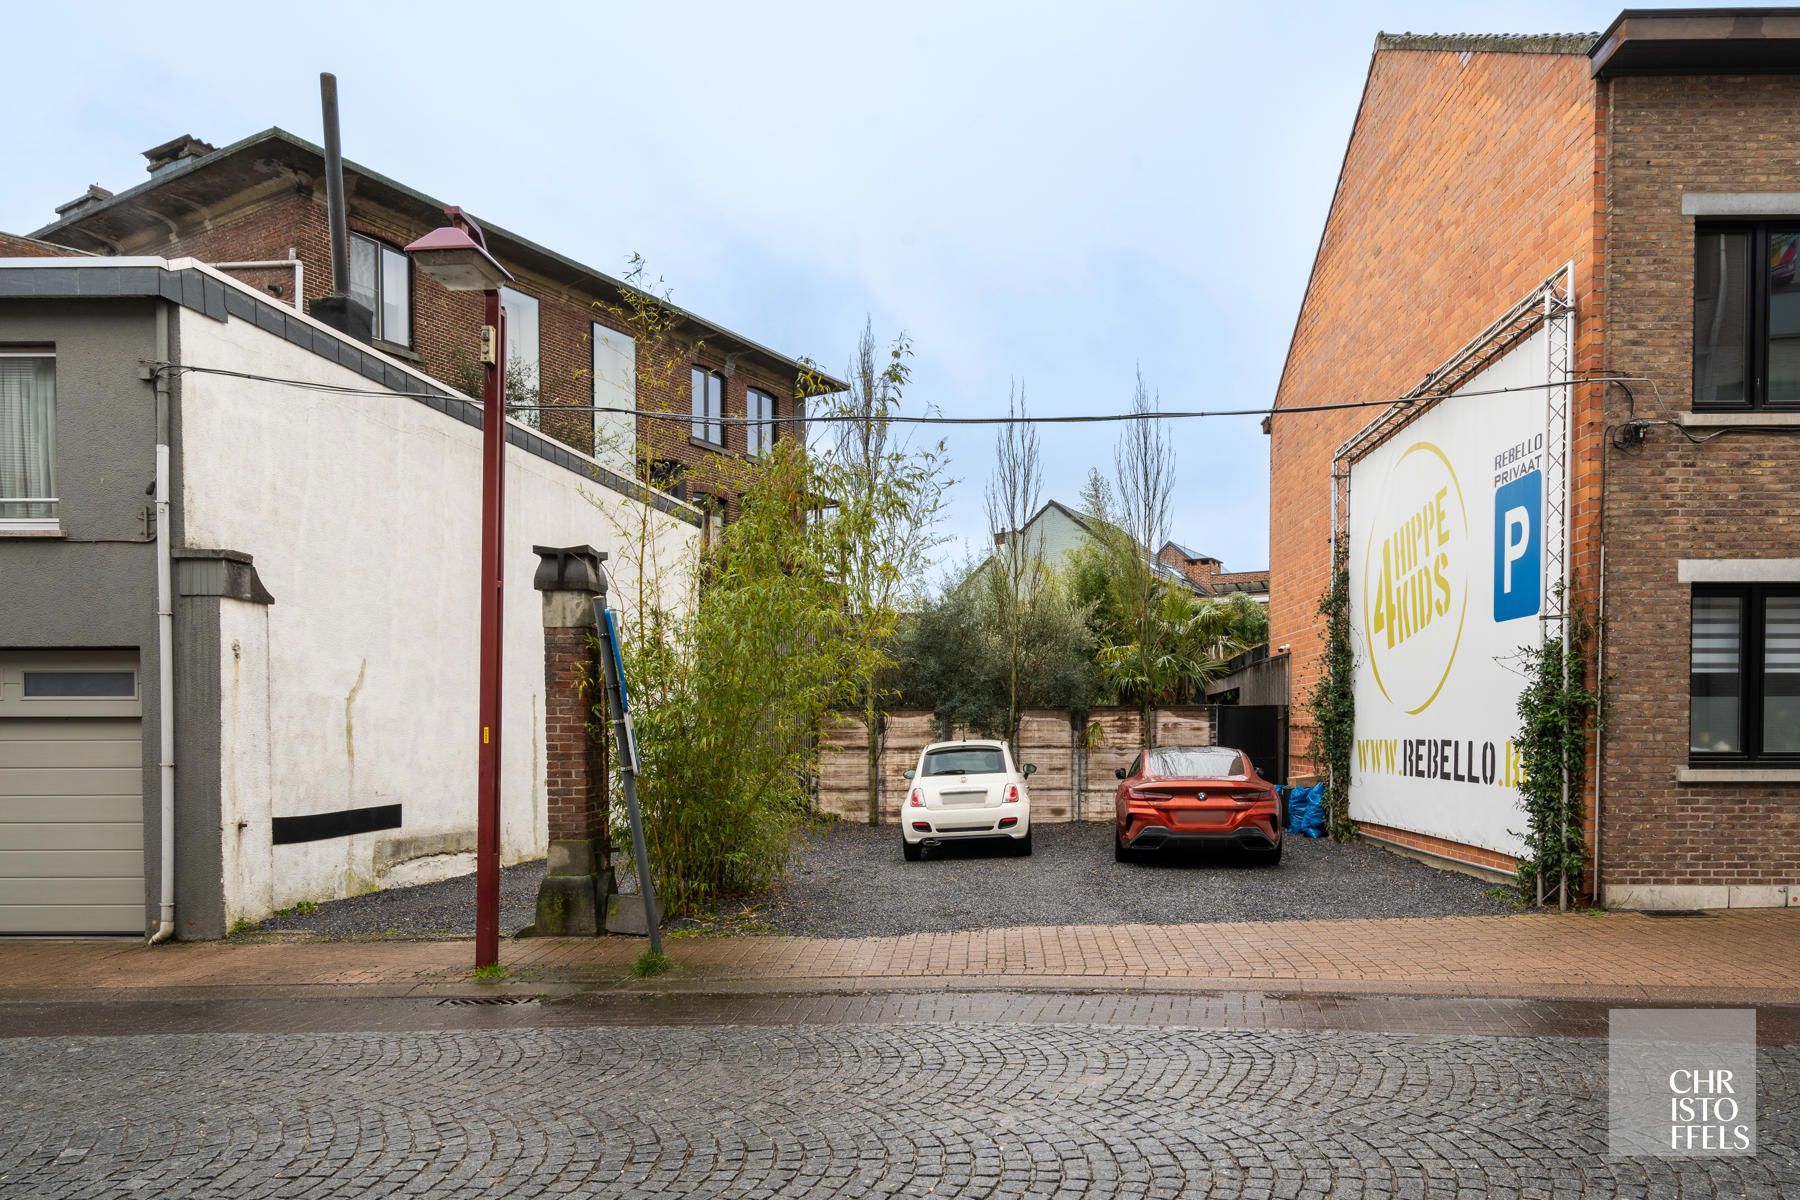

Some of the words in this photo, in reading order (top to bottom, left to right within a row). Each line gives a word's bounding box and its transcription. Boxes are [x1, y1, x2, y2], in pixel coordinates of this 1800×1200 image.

[1494, 432, 1543, 471] REBELLO
[1494, 454, 1542, 489] PRIVAAT
[1503, 505, 1530, 594] P
